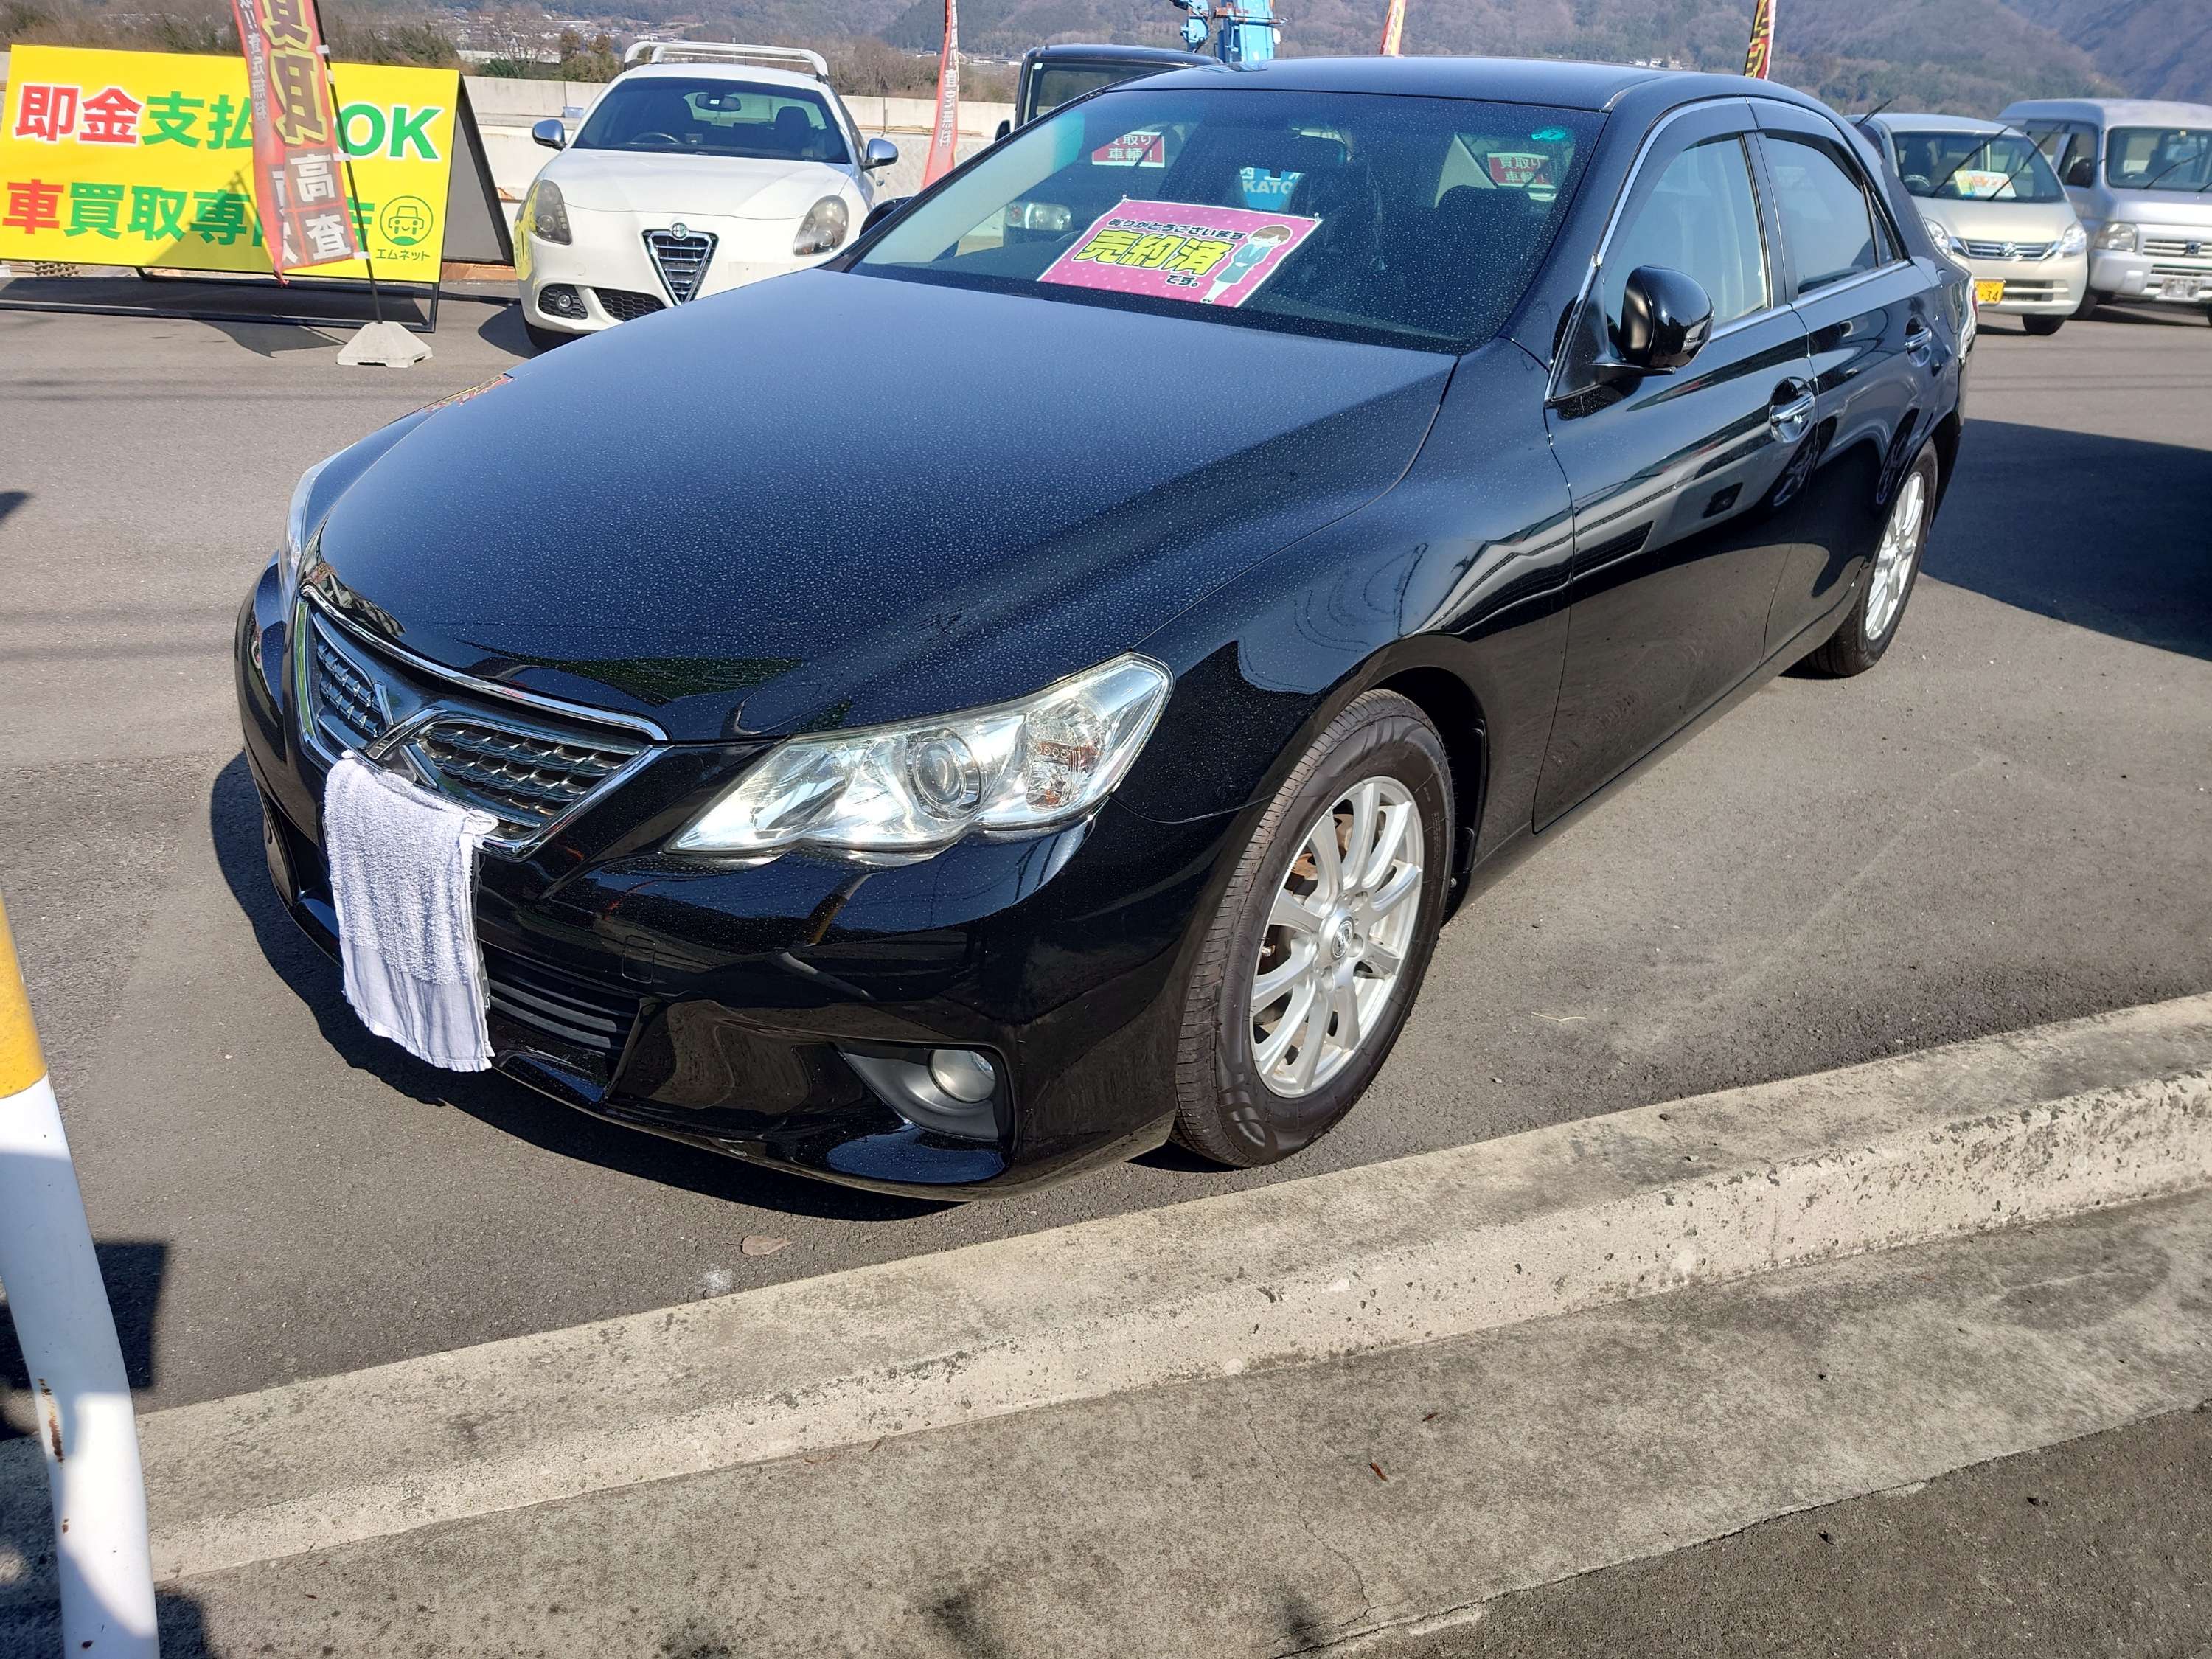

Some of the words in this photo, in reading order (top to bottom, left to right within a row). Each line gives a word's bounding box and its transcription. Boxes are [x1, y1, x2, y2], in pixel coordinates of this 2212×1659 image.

[1107, 218, 1248, 241] ありがとうございます
[375, 248, 431, 261] エムネット
[1071, 229, 1237, 277] 売約済
